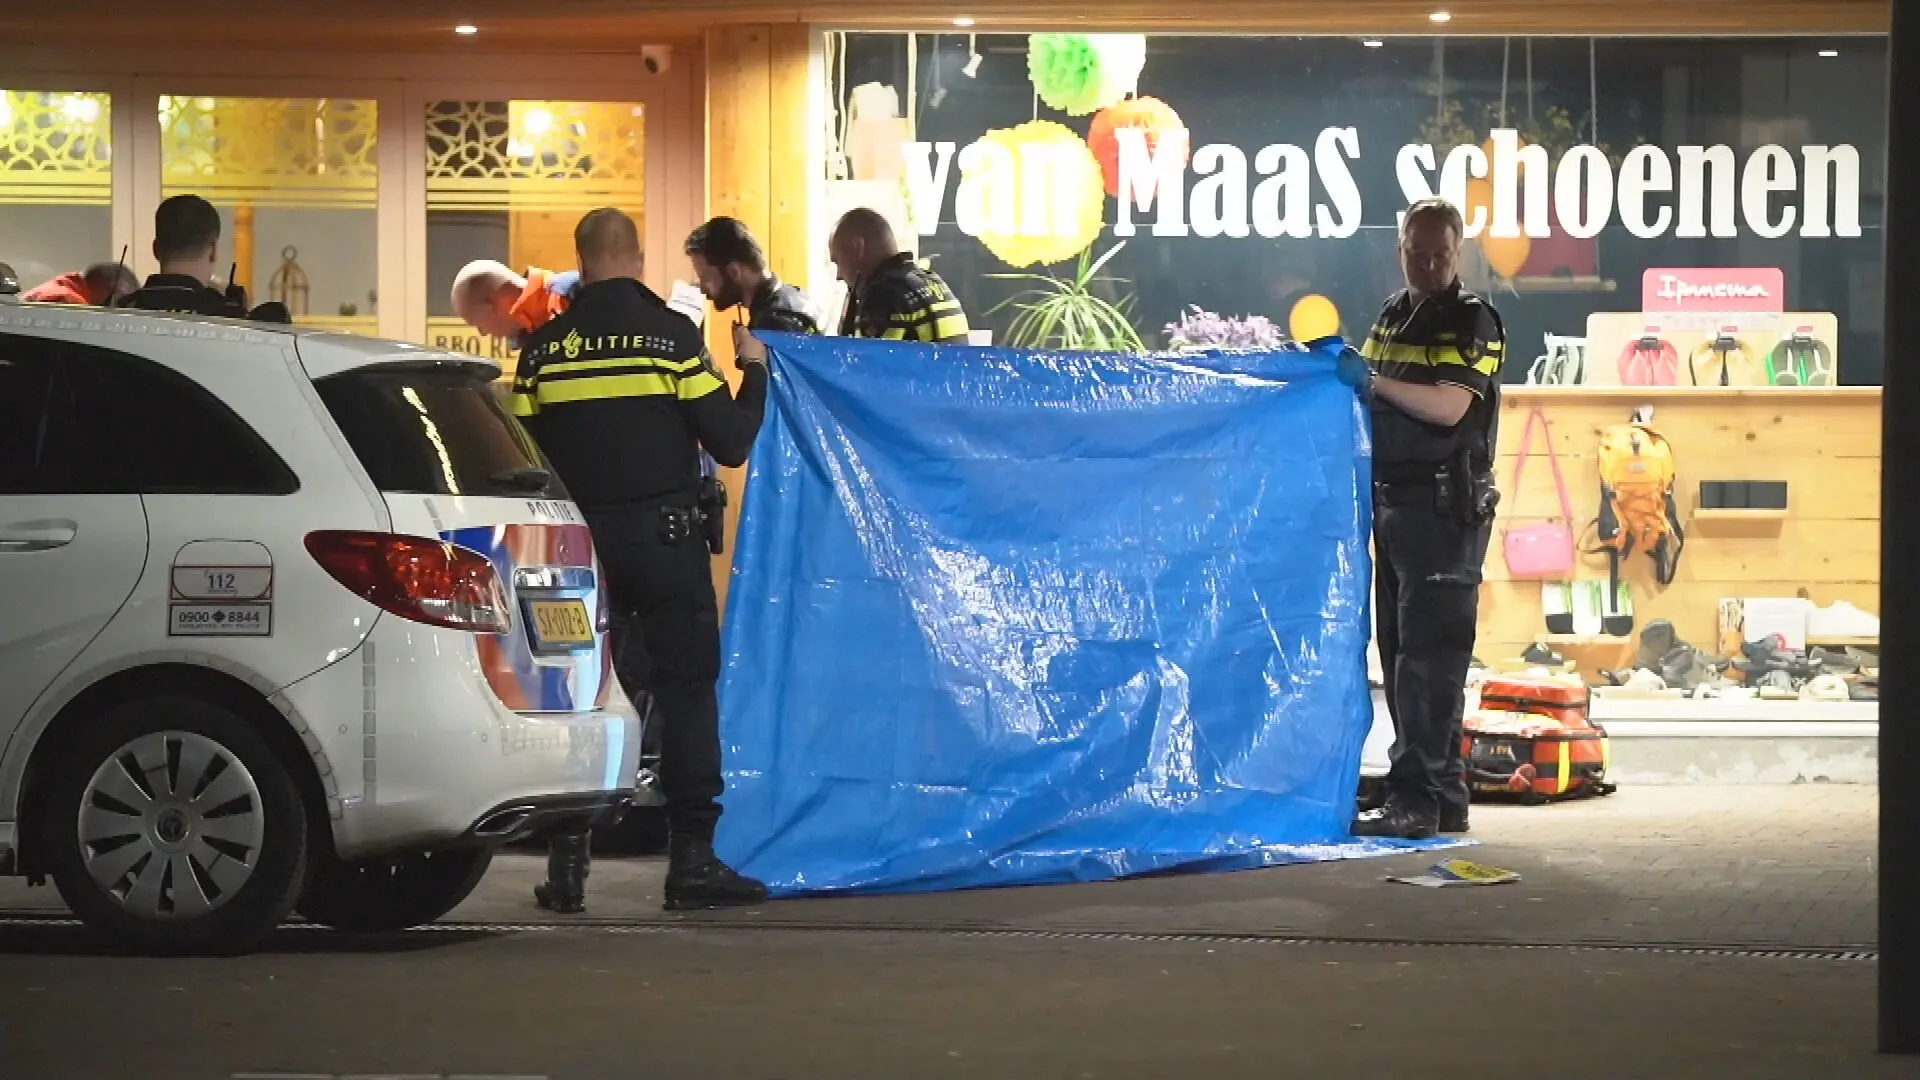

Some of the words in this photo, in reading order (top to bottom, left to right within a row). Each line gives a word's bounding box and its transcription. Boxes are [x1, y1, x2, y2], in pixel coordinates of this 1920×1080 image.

[901, 141, 1080, 236] van
[1395, 128, 1862, 238] schoenen
[1656, 274, 1770, 307] Ipanema
[549, 329, 644, 358] POLITIE
[526, 501, 575, 521] POLITIE
[208, 573, 235, 589] 112
[179, 611, 209, 623] 0900
[227, 611, 260, 623] 8844
